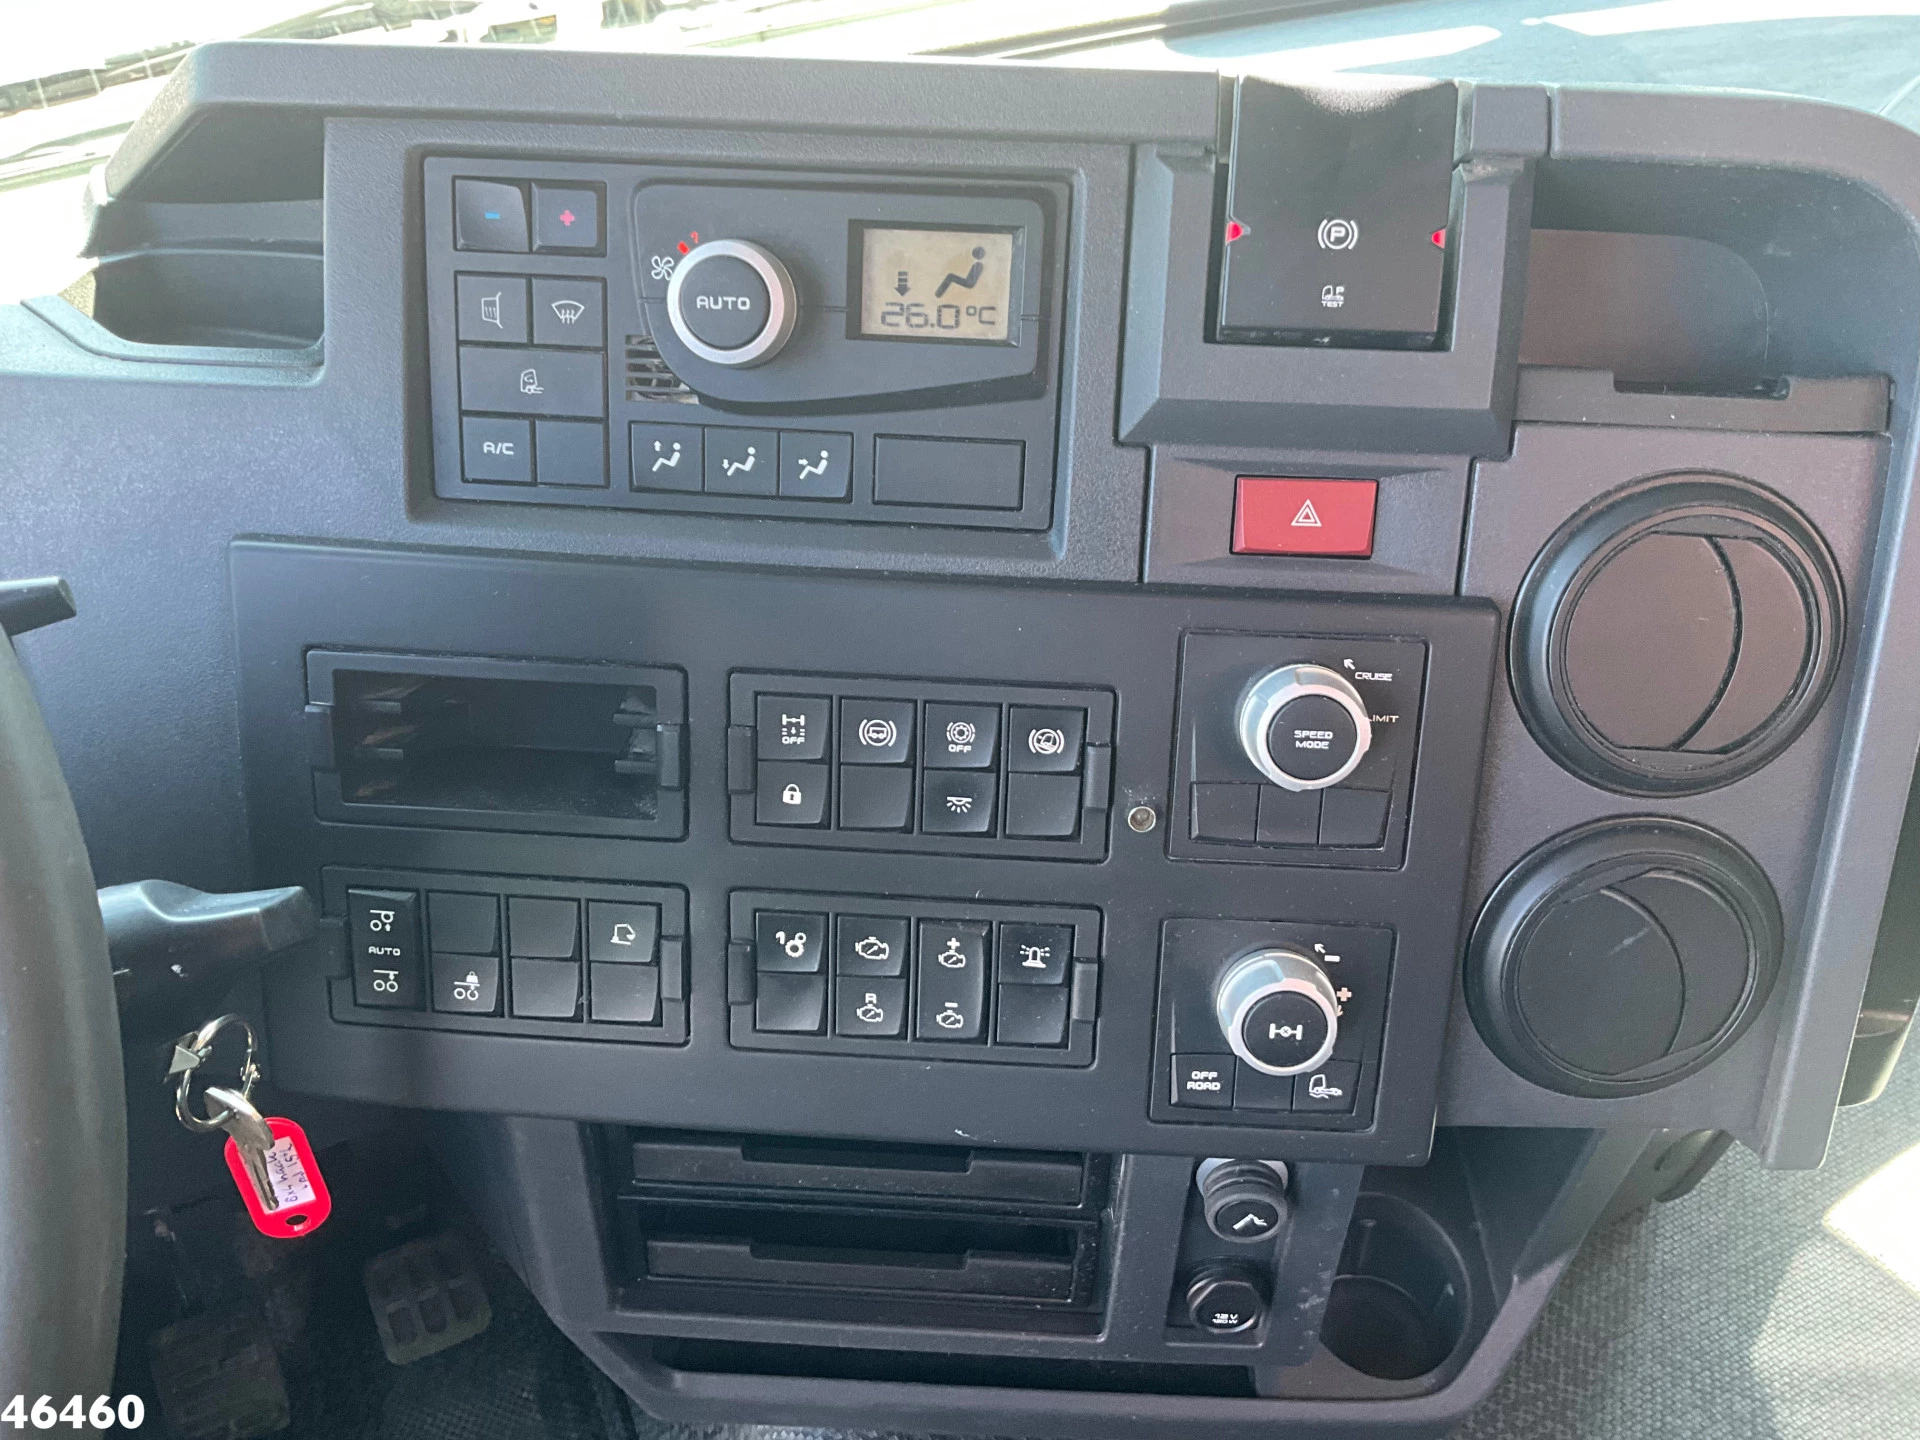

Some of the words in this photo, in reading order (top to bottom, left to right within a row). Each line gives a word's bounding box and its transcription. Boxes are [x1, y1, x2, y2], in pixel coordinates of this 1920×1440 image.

[696, 295, 751, 311] AUTO
[1321, 300, 1344, 308] TEST
[483, 441, 515, 455] A/C
[1354, 671, 1393, 682] CRUISE
[781, 735, 806, 745] OFF
[1293, 729, 1334, 740] SPEED
[948, 743, 972, 753] OFF
[1295, 740, 1330, 750] MODE
[368, 945, 401, 957] AUTO
[1191, 1070, 1218, 1081] OFF
[1186, 1080, 1221, 1091] ROAD
